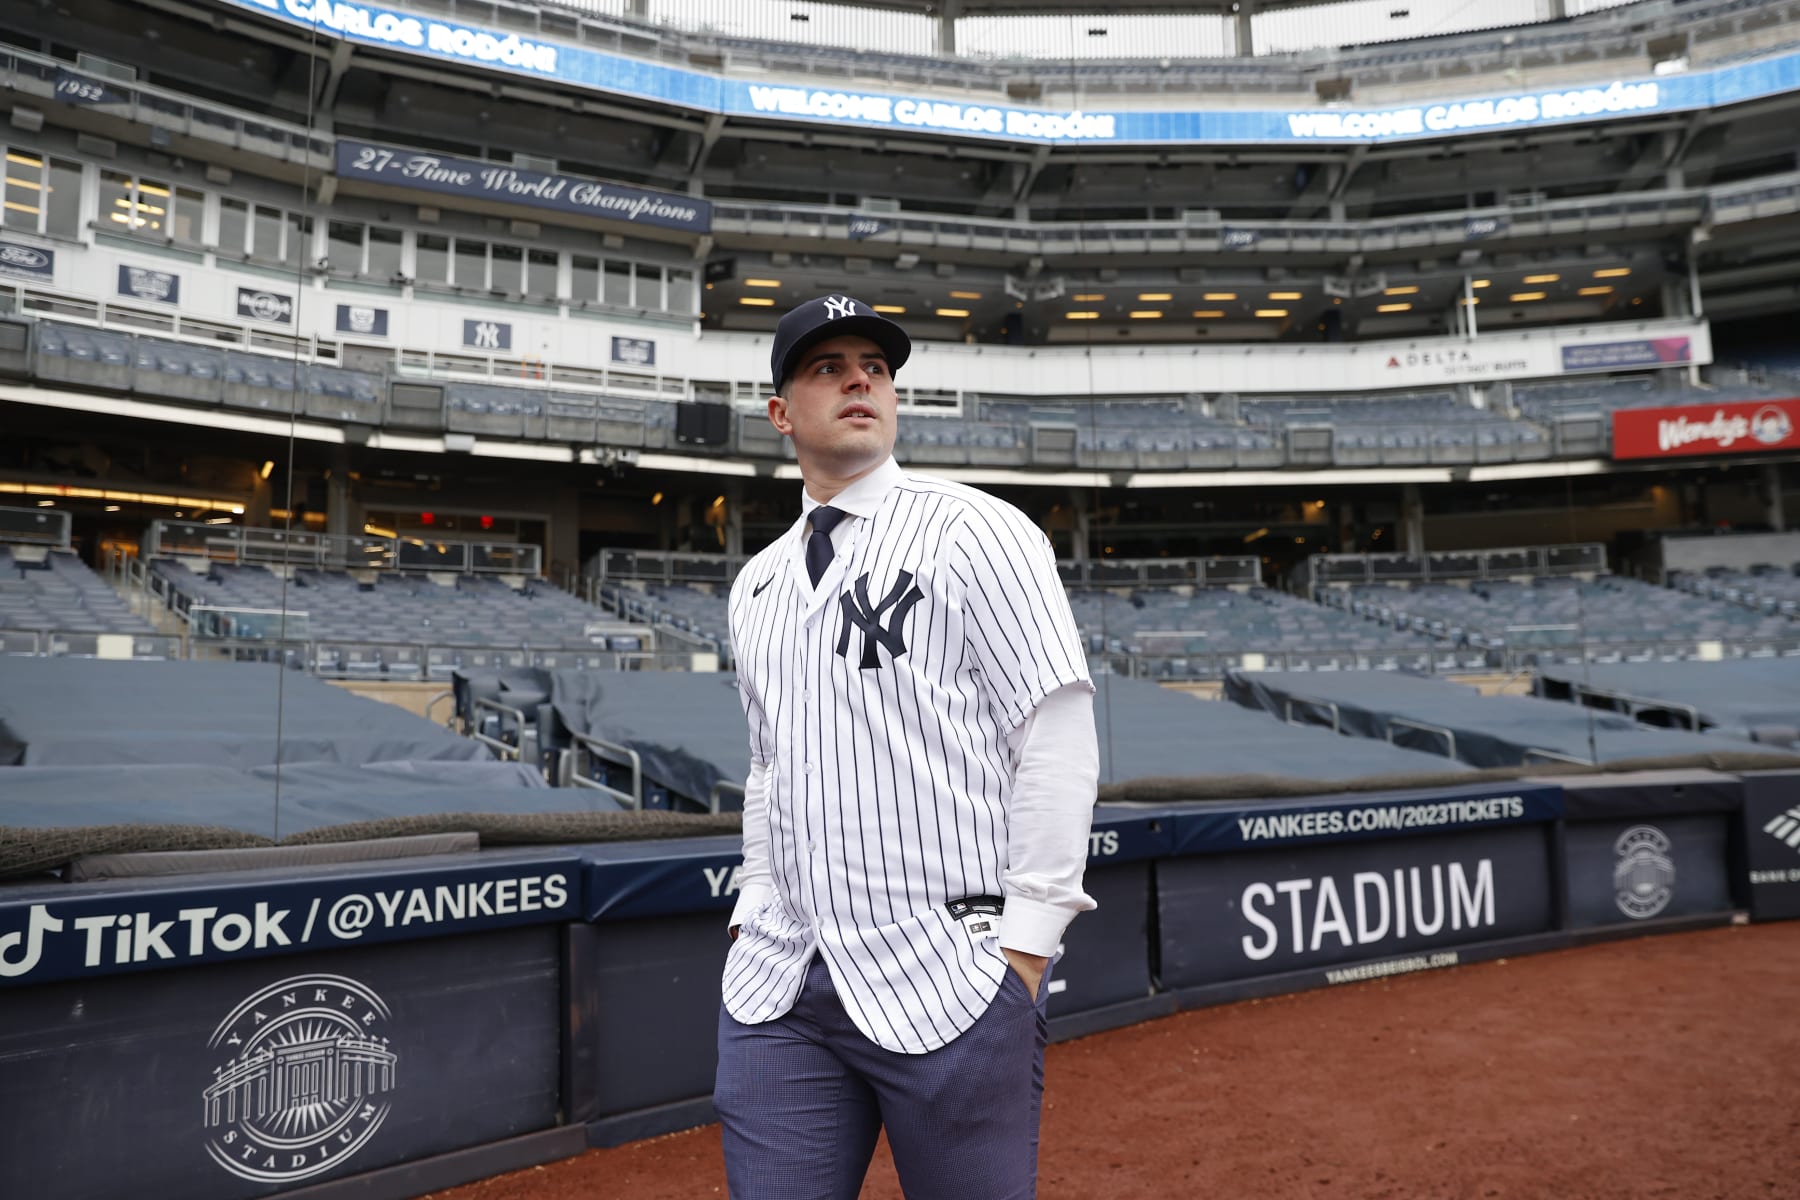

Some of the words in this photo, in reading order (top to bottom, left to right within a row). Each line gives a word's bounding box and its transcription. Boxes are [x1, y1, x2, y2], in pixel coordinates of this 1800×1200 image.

[749, 86, 893, 123] WELCOME
[894, 99, 1003, 133] CARLOS
[1288, 109, 1423, 138] WELCOME
[1424, 96, 1537, 131] CARLOS
[352, 147, 474, 187] 27-Time
[480, 169, 565, 201] World
[568, 182, 697, 222] Champions
[1405, 348, 1472, 368] DELTA
[1658, 409, 1749, 451] Wendy's
[1238, 796, 1525, 841] YANKEES.COM/2023TICKETS
[74, 902, 292, 968] TikTok
[327, 873, 569, 940] @YANKEES
[1241, 858, 1496, 961] STADIUM
[217, 988, 377, 1047] YANKEE
[222, 1103, 377, 1169] STADIUM
